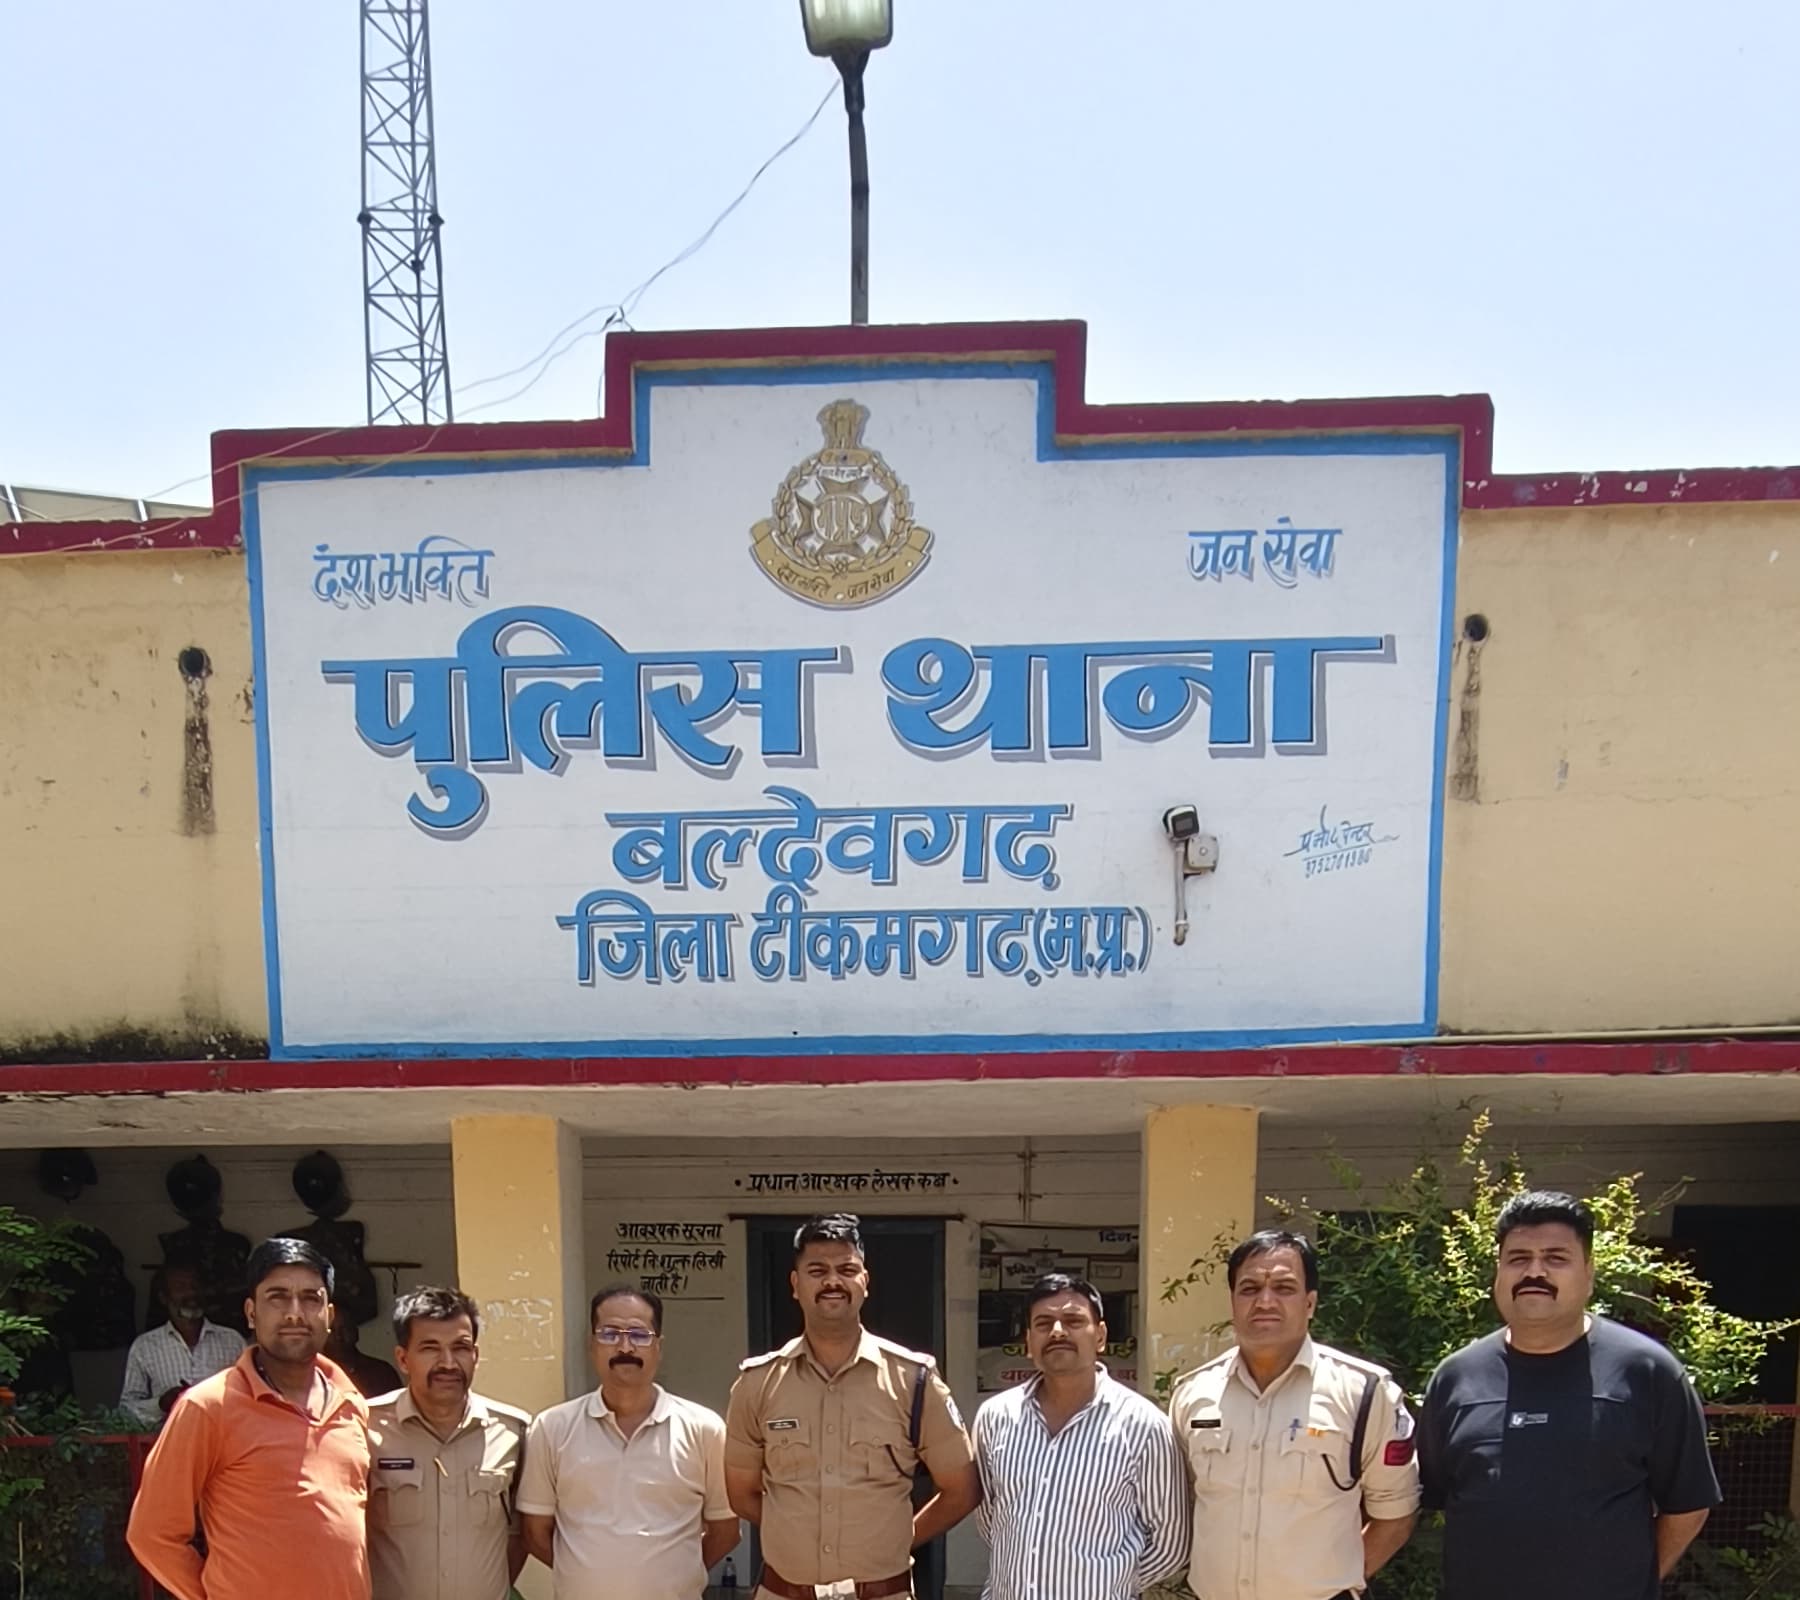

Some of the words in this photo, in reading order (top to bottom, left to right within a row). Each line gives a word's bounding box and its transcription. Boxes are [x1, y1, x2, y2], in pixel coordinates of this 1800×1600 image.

[320, 605, 852, 841] पुलिस
[881, 636, 1396, 762] थाना
[555, 890, 743, 985] जिला
[747, 1174, 799, 1193] प्रधान
[800, 1174, 870, 1193] आरक्षक
[616, 1223, 681, 1241] आवश्यक
[682, 1222, 724, 1241] सूचना
